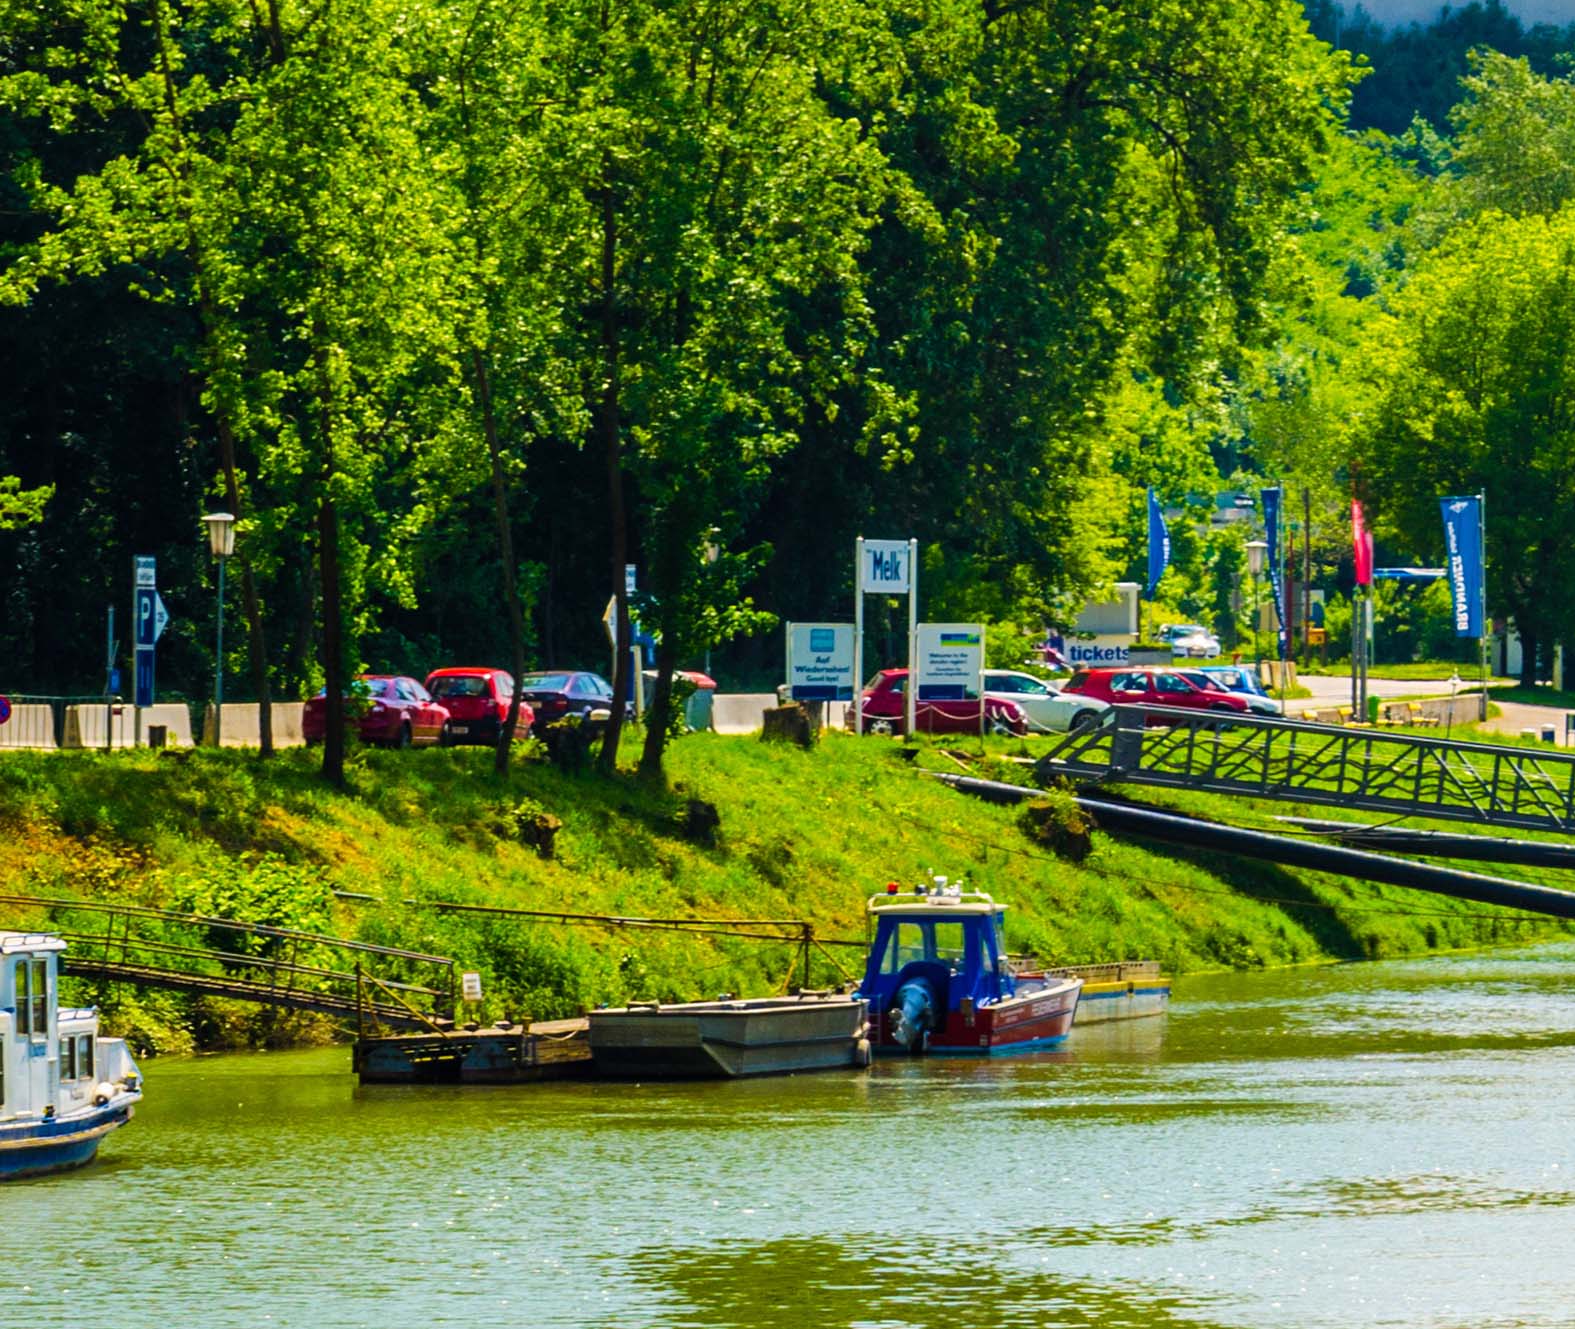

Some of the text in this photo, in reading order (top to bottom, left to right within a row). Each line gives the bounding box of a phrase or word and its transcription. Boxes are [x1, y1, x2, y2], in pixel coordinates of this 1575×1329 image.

[872, 550, 901, 581] Melk
[140, 596, 151, 638] P
[1070, 646, 1128, 661] tickets
